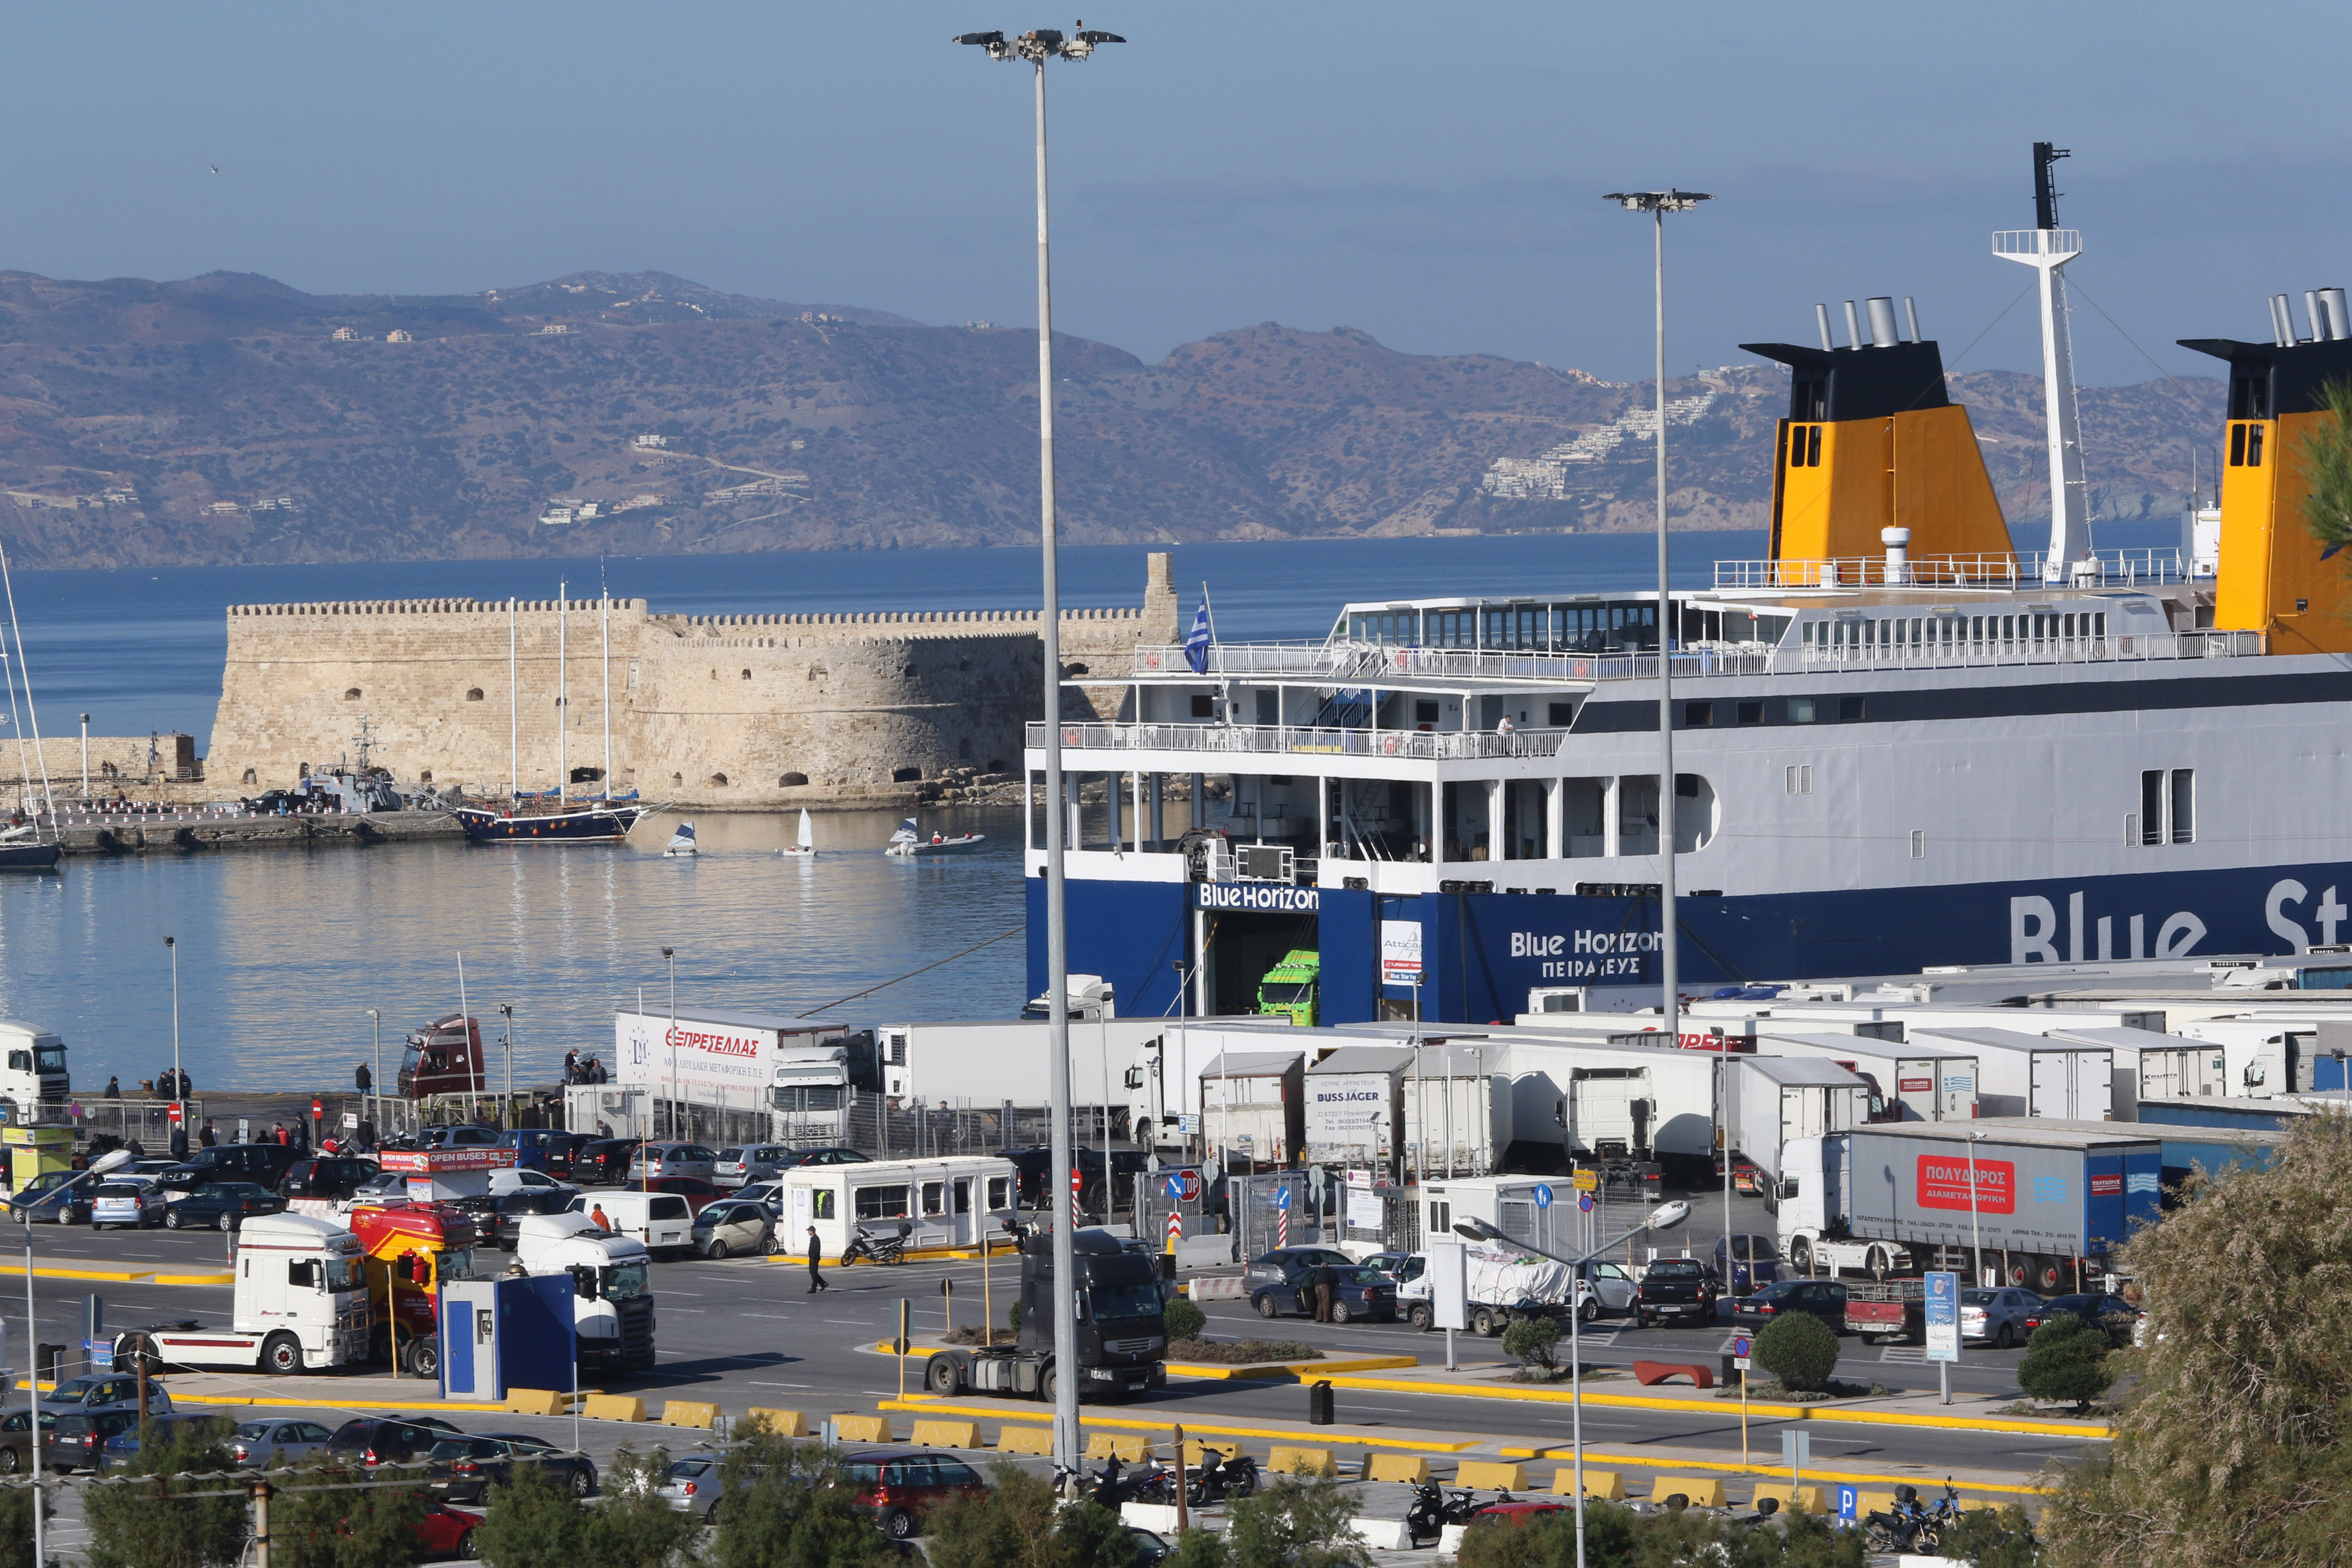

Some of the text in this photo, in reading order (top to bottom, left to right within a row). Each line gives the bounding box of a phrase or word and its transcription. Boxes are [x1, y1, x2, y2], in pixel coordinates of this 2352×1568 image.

[1383, 940, 1419, 949] Attica
[1511, 929, 1664, 957] Blue Horizon
[1542, 957, 1640, 979] ΠΕΙΡΑΙΕΥΣ
[679, 1059, 708, 1071] ΛΙΟΥΔΑΚΗ
[708, 1063, 747, 1077] ΜΕΤΑΦΟΡΙΚΗ
[1180, 1119, 1185, 1130] P
[456, 1152, 487, 1161] BUSES
[1926, 1166, 2005, 1186] ΠΟΛΥΔΩΡΟΣ
[1182, 1177, 1198, 1194] TOP
[1842, 1490, 1853, 1514] P
